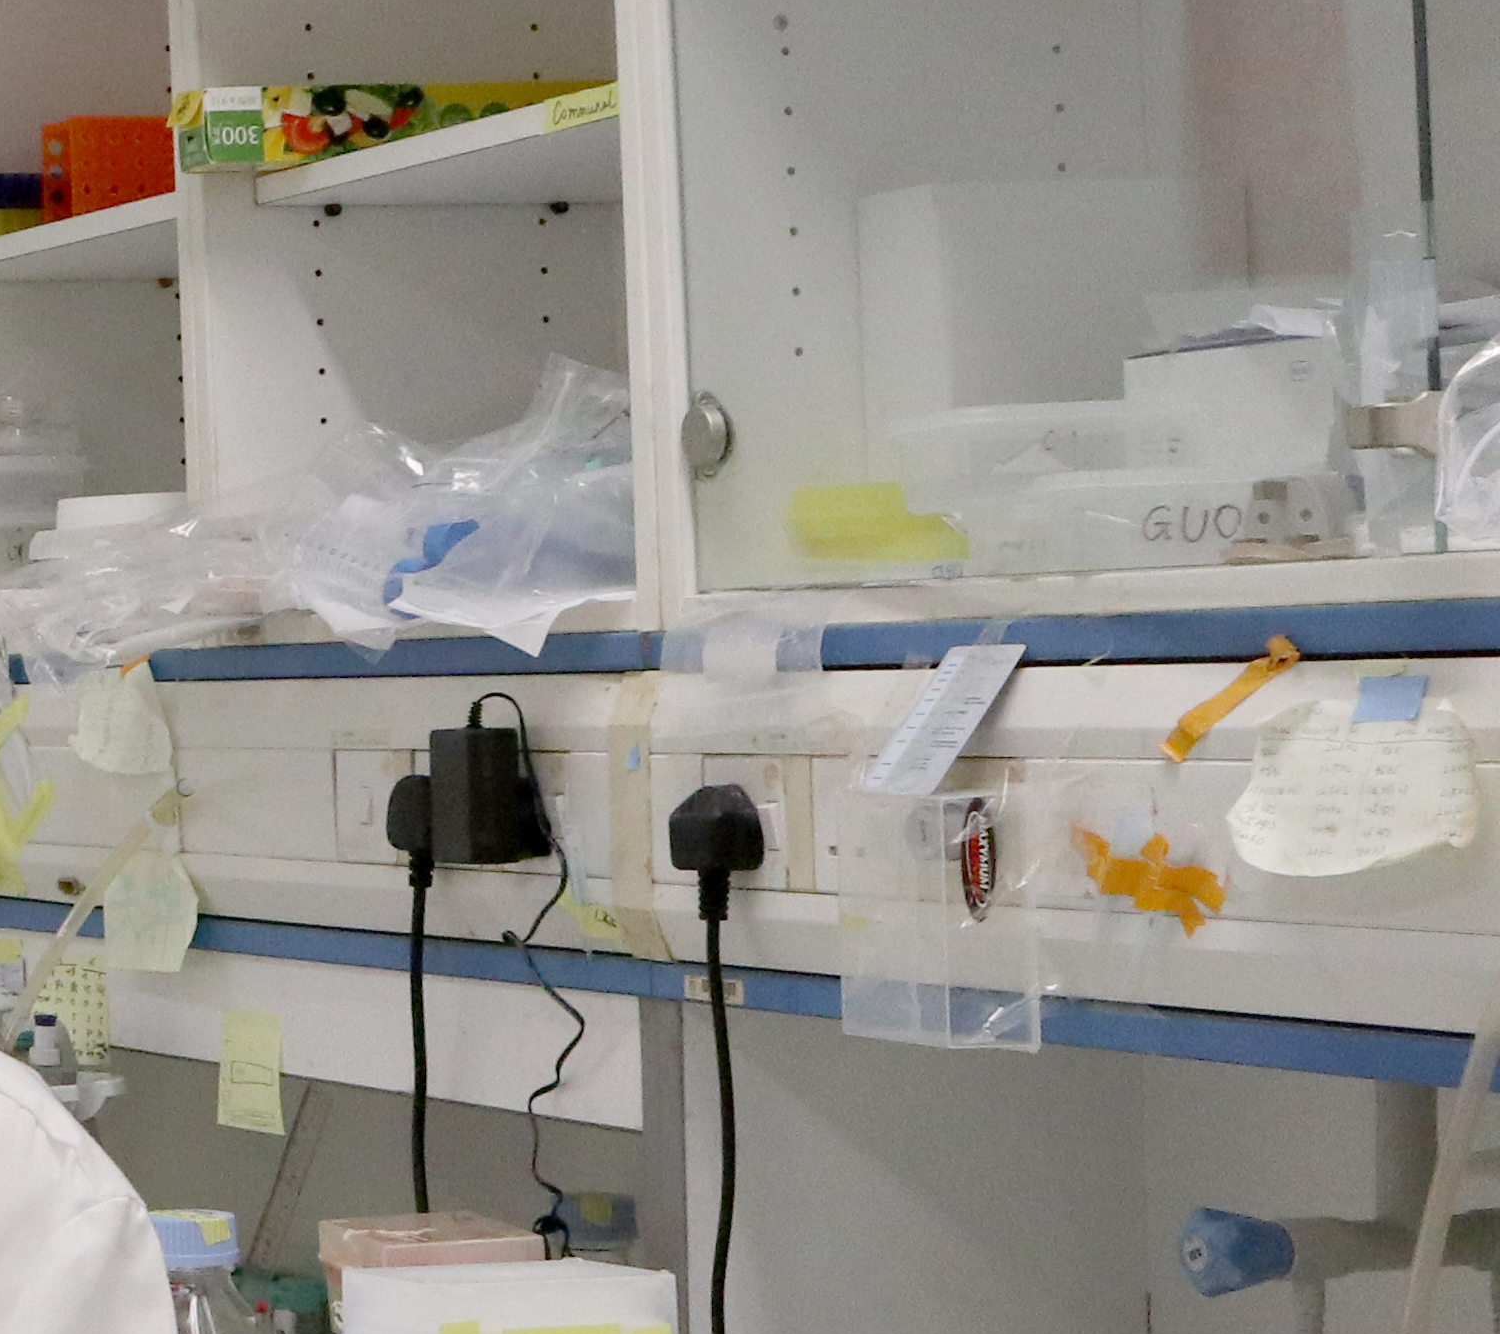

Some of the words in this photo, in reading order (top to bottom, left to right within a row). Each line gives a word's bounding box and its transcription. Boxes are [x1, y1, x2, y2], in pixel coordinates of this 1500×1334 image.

[551, 88, 617, 125] Communal
[221, 123, 260, 146] 300
[1142, 504, 1243, 543] GUO
